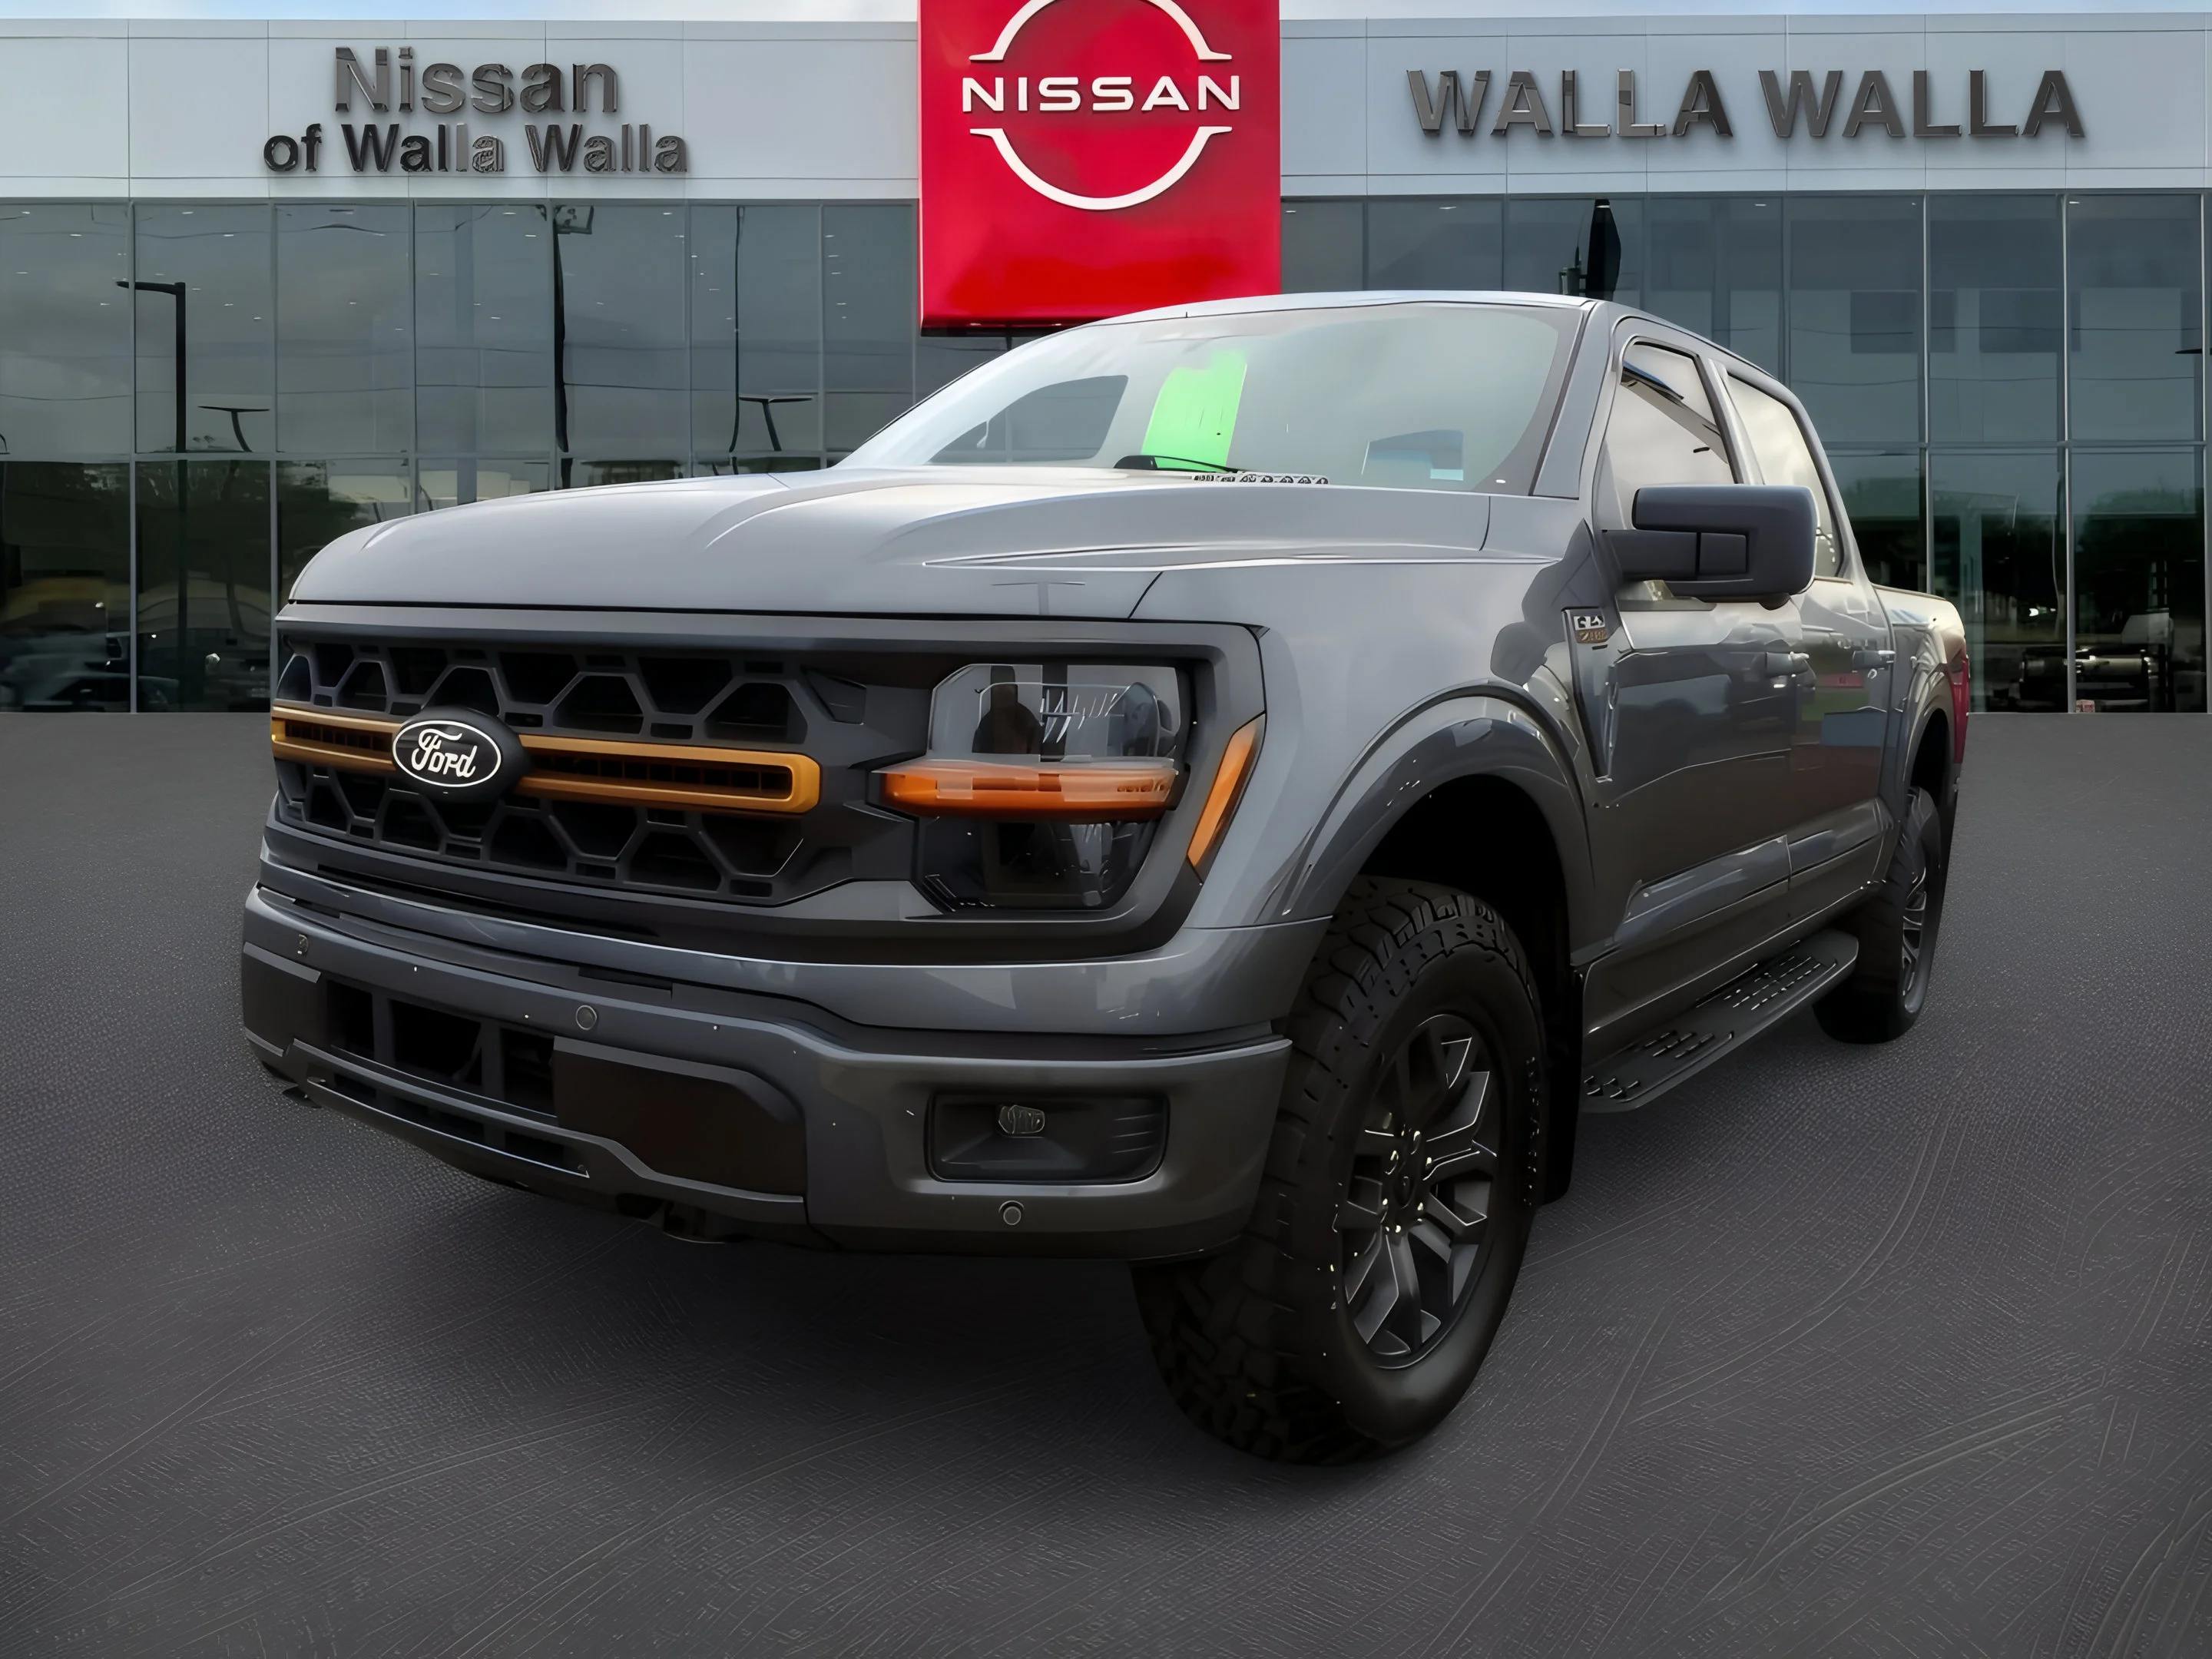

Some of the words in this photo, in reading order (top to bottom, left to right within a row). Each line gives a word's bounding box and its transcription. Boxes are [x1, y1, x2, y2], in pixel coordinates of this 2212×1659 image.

[335, 46, 618, 114] Nissan
[962, 75, 1240, 112] NISSAN
[1406, 69, 1734, 137] WALLA
[1758, 69, 2085, 137] WALLA
[263, 123, 323, 173] of
[340, 123, 505, 173] Walla
[525, 123, 687, 173] Walla
[411, 728, 478, 778] Ford
